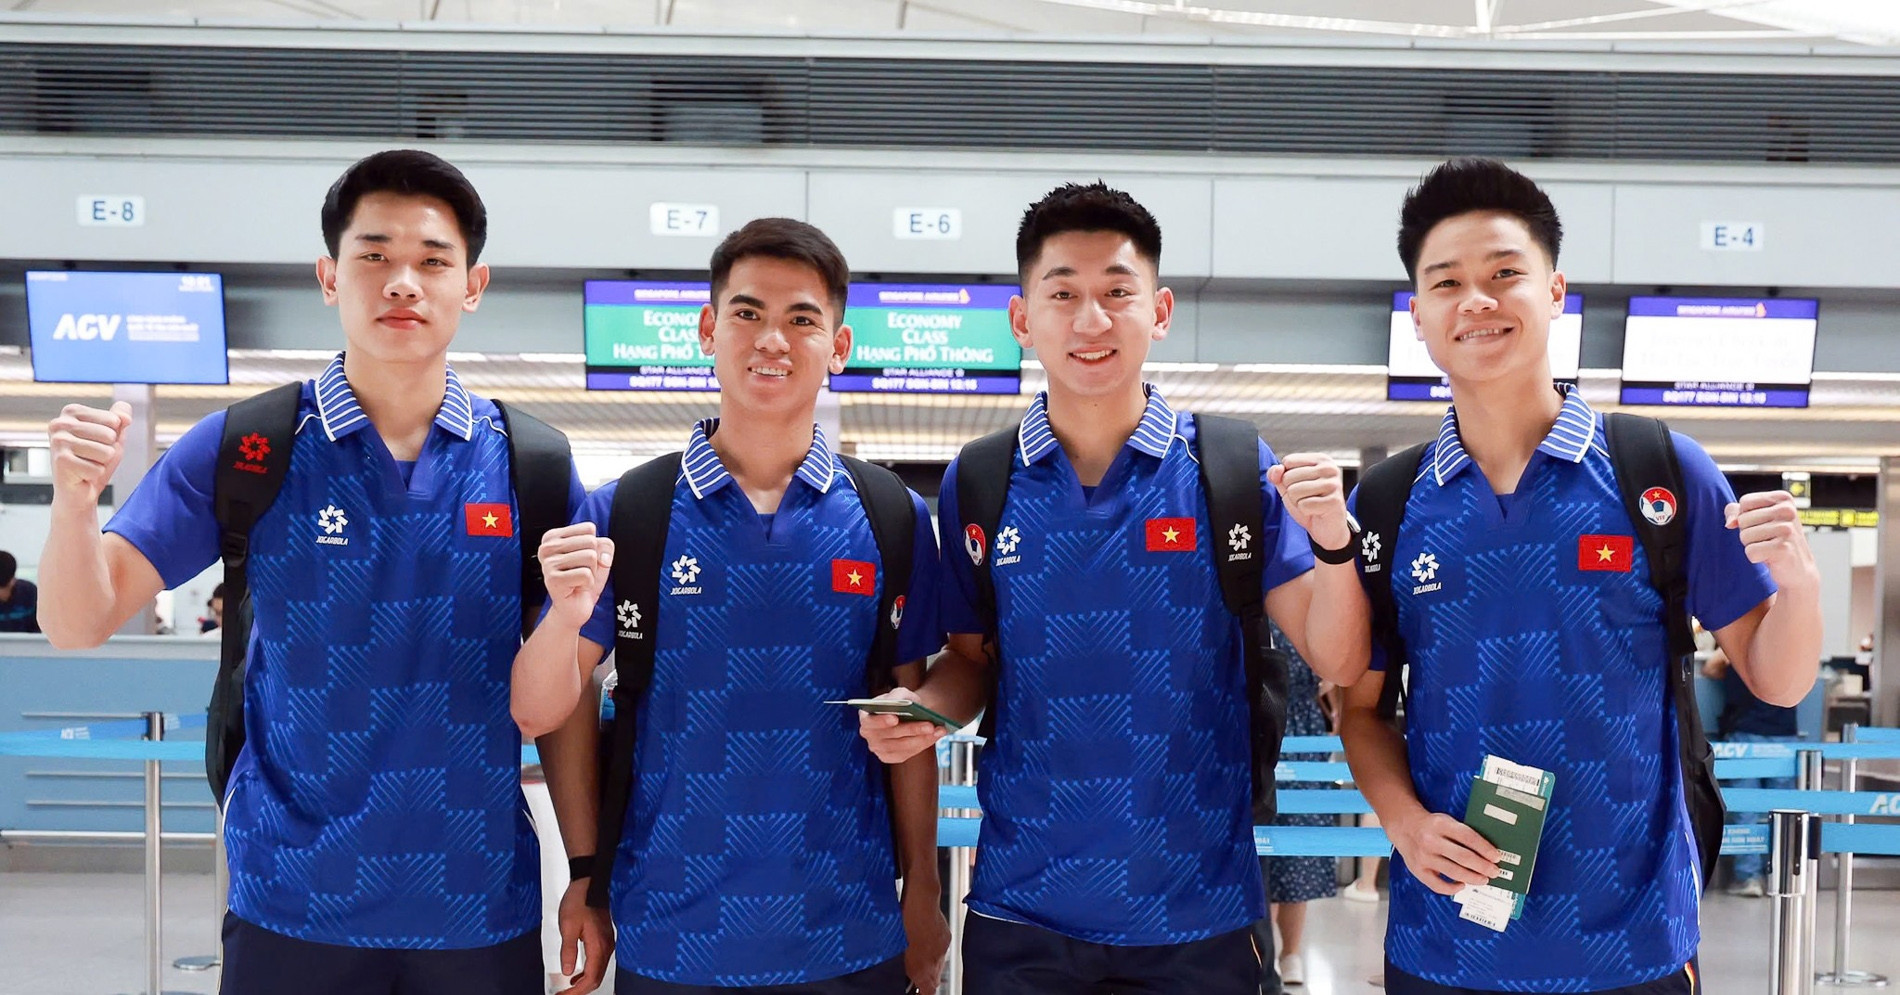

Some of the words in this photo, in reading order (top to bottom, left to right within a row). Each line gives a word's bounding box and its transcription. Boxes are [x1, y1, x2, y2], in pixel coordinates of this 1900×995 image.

[93, 200, 134, 221] E-8
[667, 209, 707, 229] E-7
[911, 213, 950, 234] E-6
[1715, 226, 1753, 246] E-4
[53, 313, 121, 341] ACV
[643, 309, 700, 326] ECONO
[887, 312, 962, 328] ECONOMY
[658, 326, 699, 343] CLAS
[902, 328, 949, 344] CLASS
[1869, 794, 1900, 815] AC
